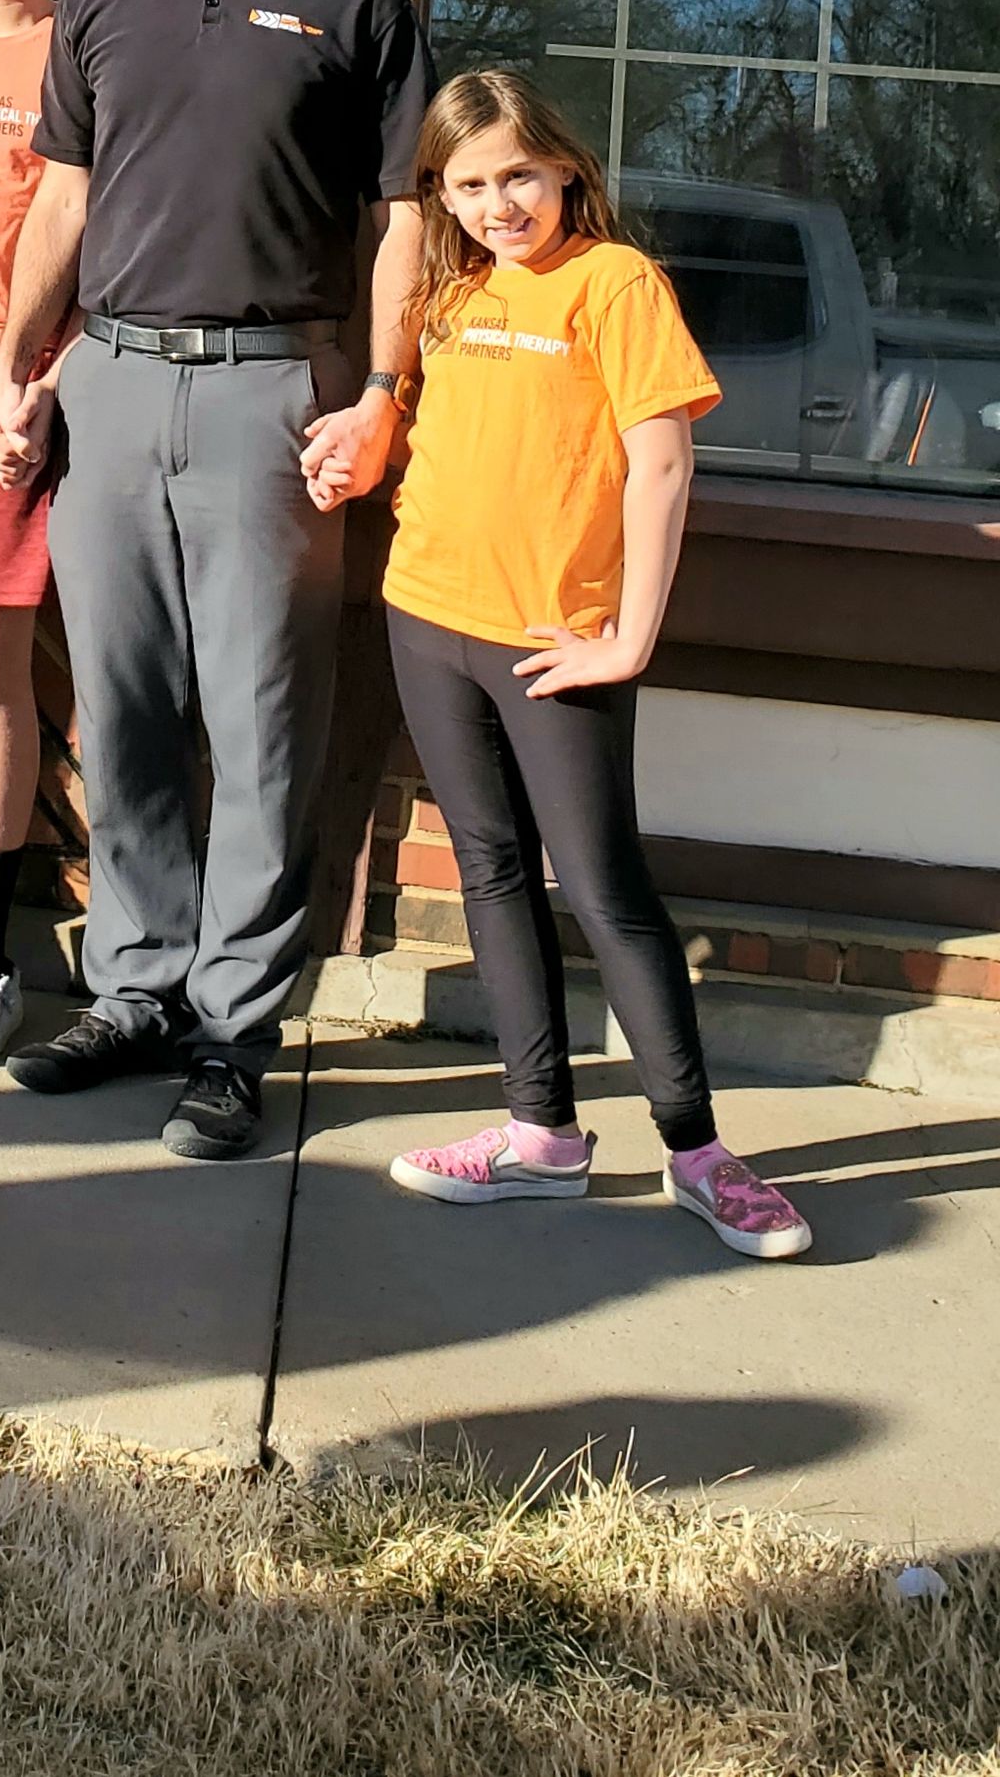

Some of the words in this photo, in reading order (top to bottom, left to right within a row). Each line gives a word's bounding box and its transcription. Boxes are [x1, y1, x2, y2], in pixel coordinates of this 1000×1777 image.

[468, 316, 510, 330] KANSAS
[459, 342, 513, 361] PARTNERS
[462, 327, 513, 346] PHYSICAL
[513, 332, 571, 357] THERAPY
